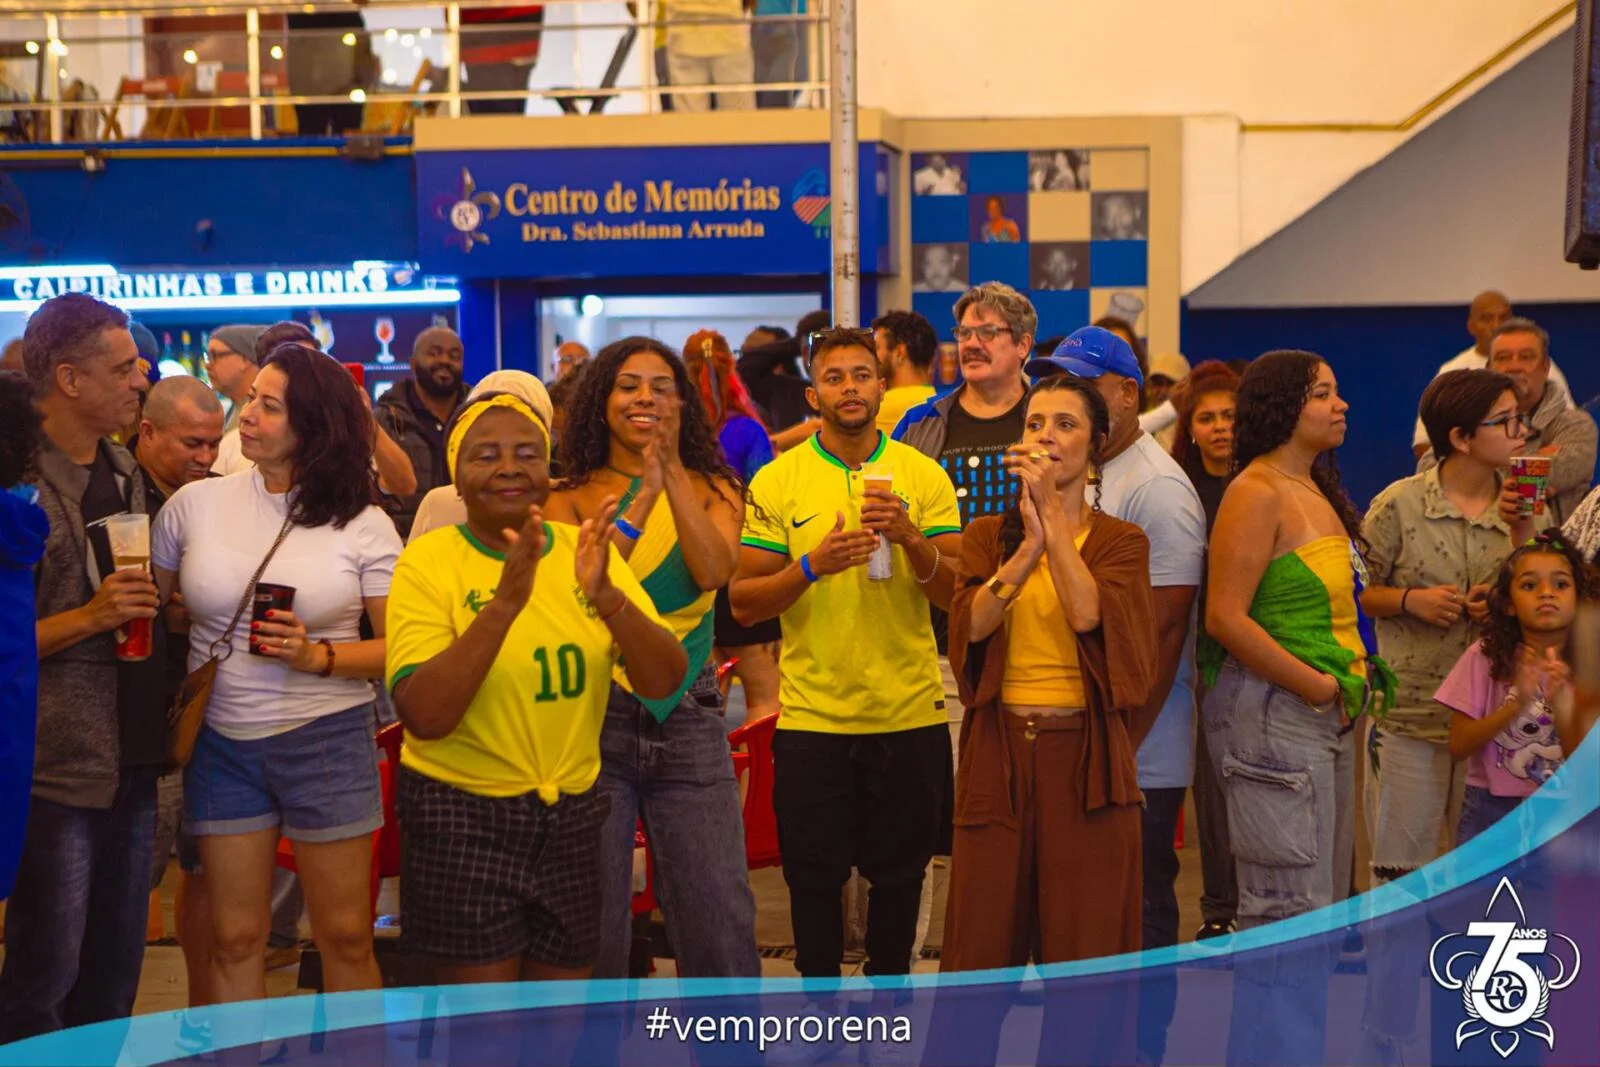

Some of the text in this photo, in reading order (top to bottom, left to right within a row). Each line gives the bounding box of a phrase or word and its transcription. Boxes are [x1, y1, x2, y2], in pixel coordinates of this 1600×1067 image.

[505, 182, 598, 216] Centro
[605, 181, 638, 214] de
[644, 178, 781, 213] Memórias
[522, 219, 765, 242] Dra. Sebastiana Arruda
[13, 267, 388, 300] CAIPIRINHAS E DRINKS
[976, 443, 1011, 452] GROOV
[533, 643, 586, 703] 10
